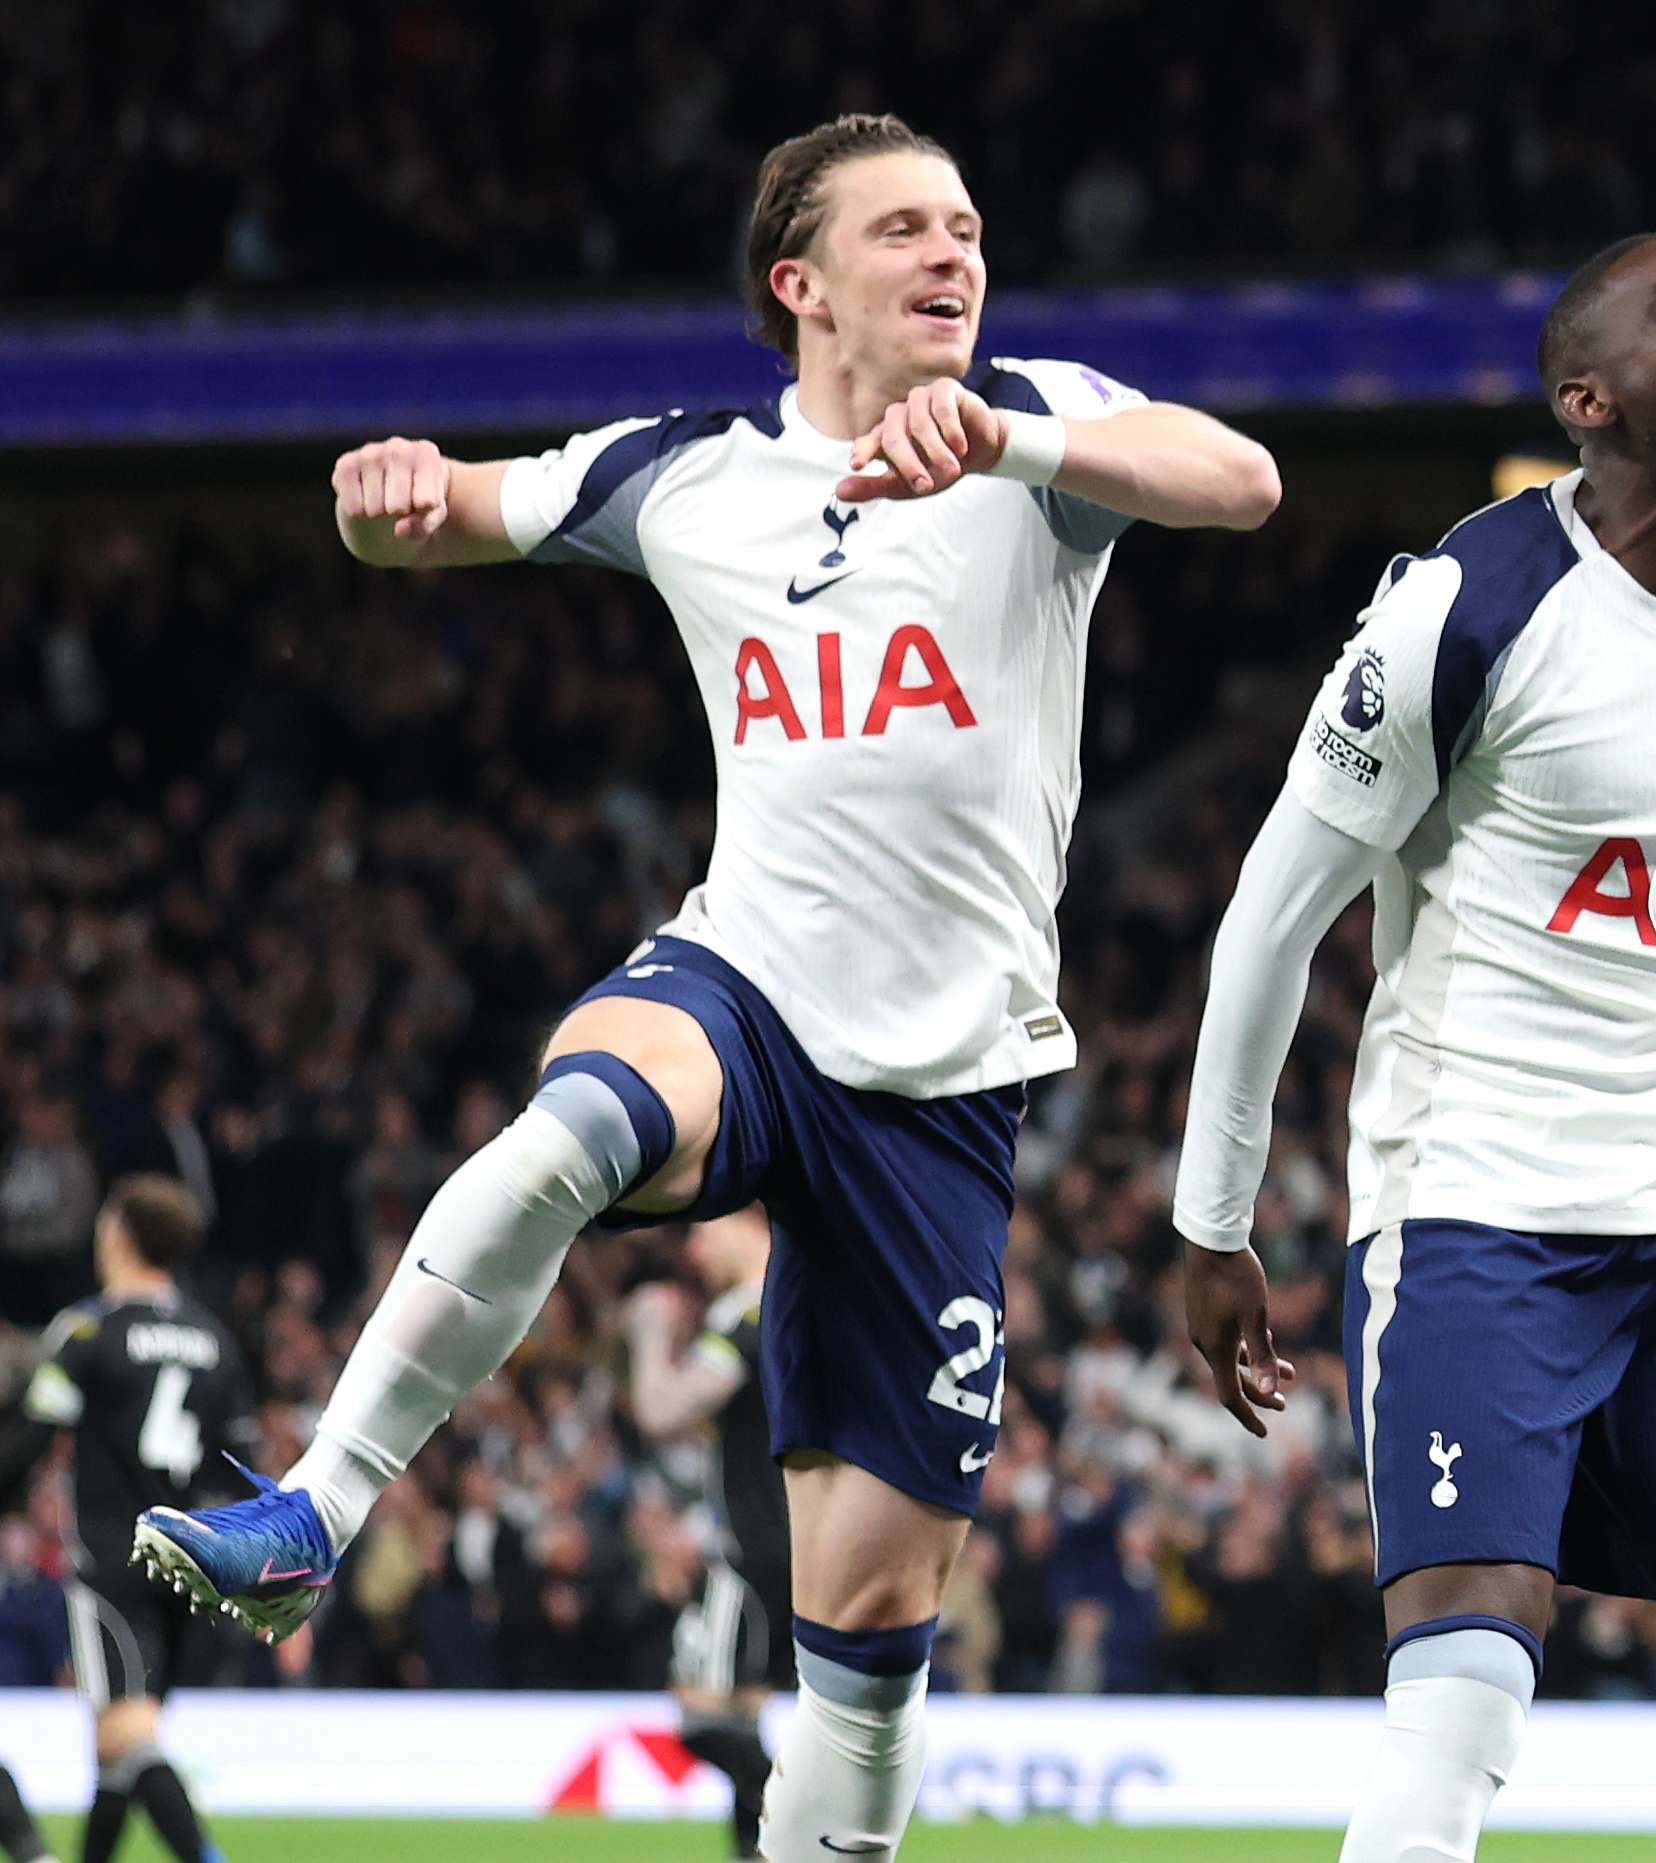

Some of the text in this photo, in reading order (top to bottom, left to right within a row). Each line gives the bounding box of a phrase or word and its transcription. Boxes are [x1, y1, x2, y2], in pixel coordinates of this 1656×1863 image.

[733, 624, 978, 745] AIA
[1326, 732, 1374, 772] room
[927, 1296, 1005, 1426] 2
[139, 1363, 204, 1489] 4
